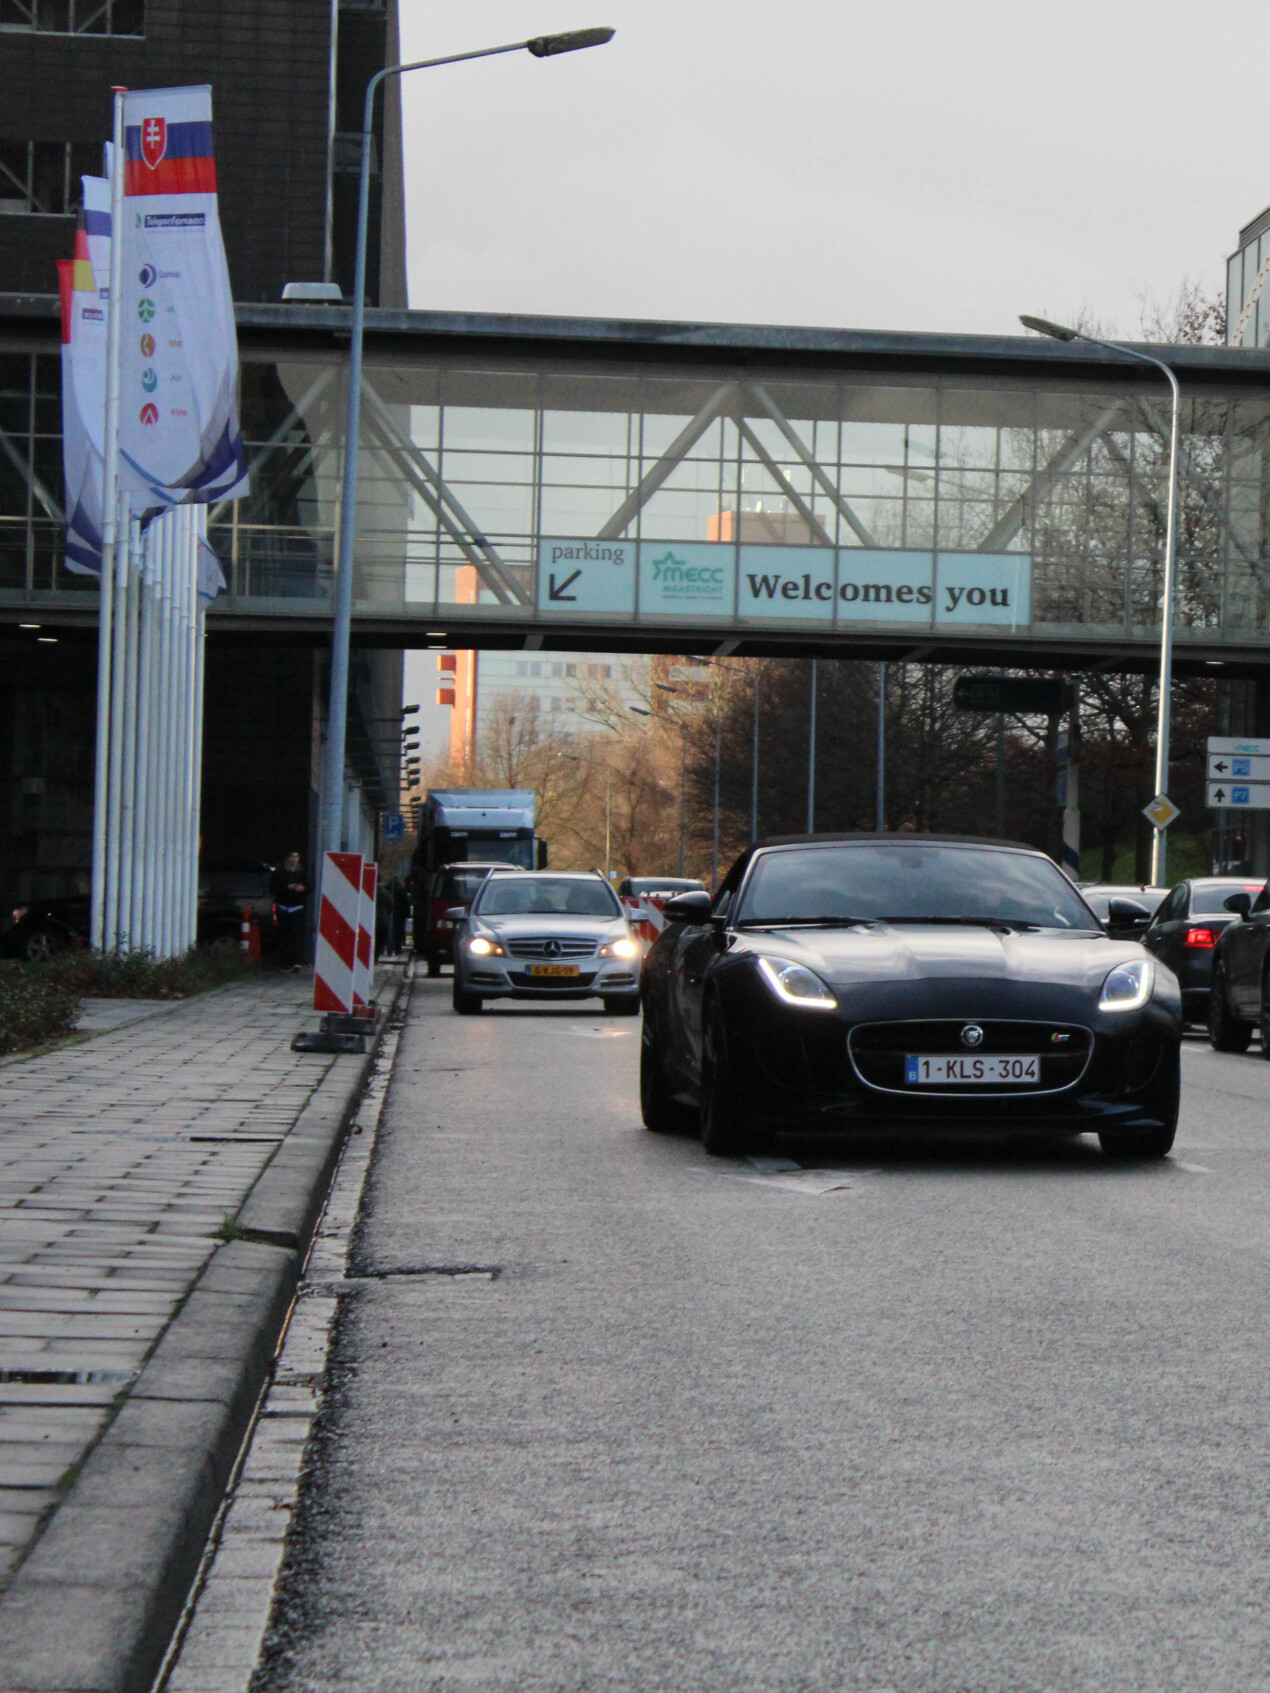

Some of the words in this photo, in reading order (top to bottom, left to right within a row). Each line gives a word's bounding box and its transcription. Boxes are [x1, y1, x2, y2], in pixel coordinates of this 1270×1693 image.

[552, 543, 625, 566] parking
[662, 585, 724, 594] MAASTRICHT
[747, 573, 933, 605] Welcomes
[945, 586, 1010, 612] you
[1234, 791, 1247, 803] P7
[388, 816, 400, 830] P
[922, 1060, 1036, 1079] 1-KLS-304
